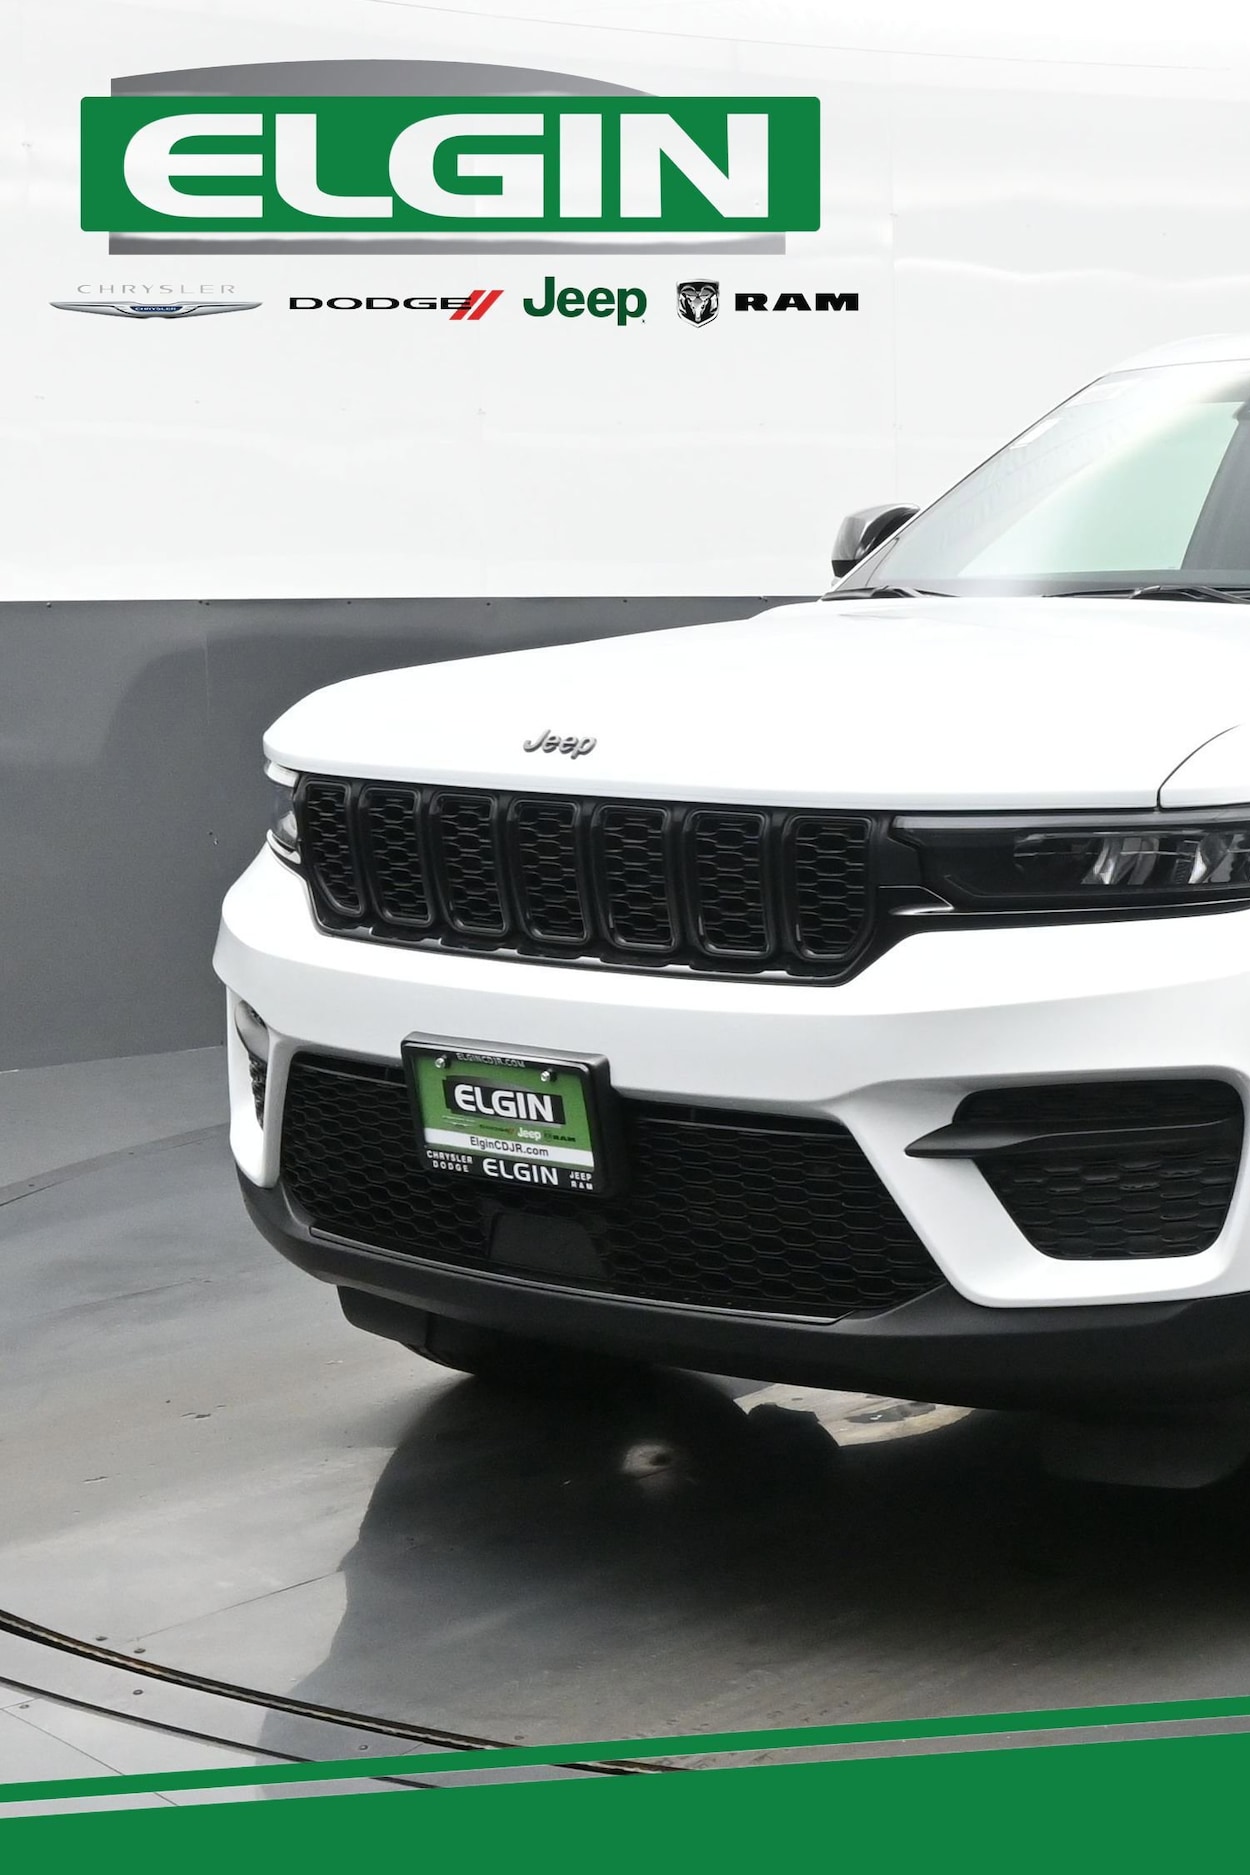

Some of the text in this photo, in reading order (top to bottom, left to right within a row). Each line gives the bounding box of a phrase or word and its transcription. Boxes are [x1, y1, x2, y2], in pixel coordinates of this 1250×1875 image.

[523, 729, 597, 760] Jeep
[454, 1083, 555, 1122] ELGIN
[517, 1127, 541, 1140] Jeep
[470, 1136, 549, 1156] ElginCDJR.com
[426, 1150, 473, 1164] CHRYSLER
[432, 1160, 470, 1173] DODGE
[482, 1158, 559, 1186] ELGIN
[569, 1171, 592, 1181] JEEP
[571, 1180, 593, 1190] RAM
